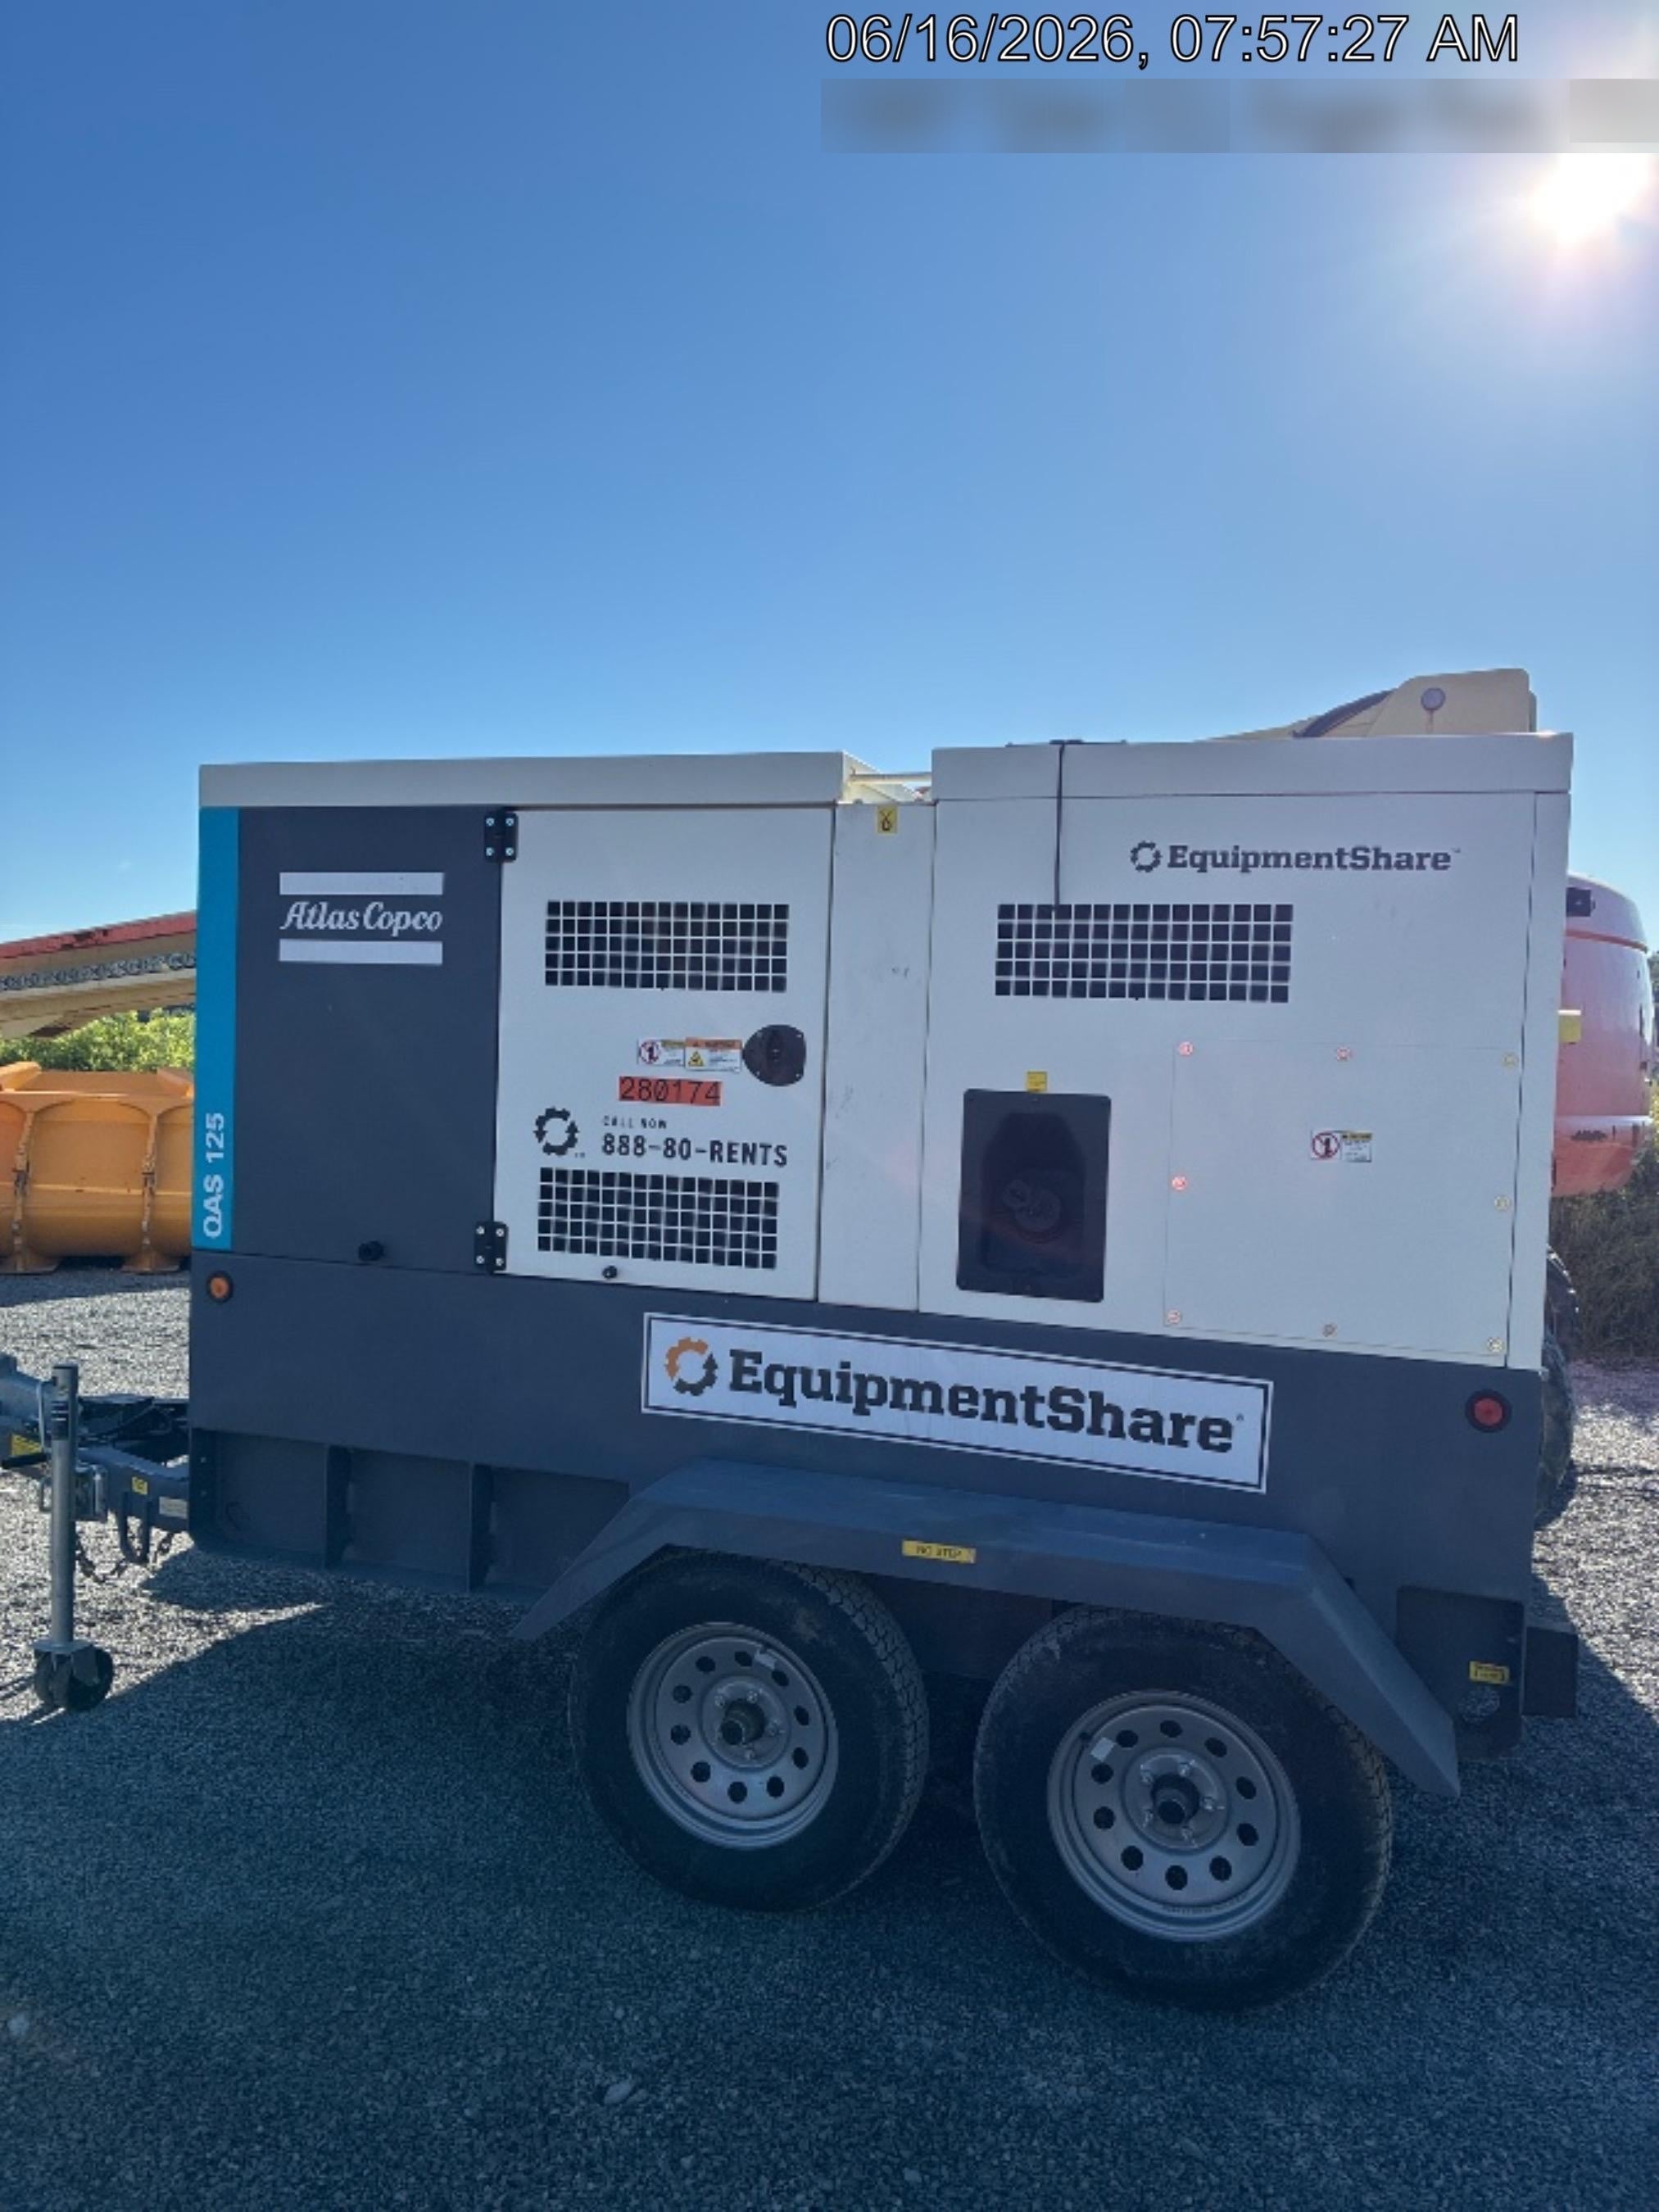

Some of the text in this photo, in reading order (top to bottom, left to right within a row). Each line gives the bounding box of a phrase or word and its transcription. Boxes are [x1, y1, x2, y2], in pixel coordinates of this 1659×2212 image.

[1167, 844, 1452, 873] EquipmentShare
[279, 901, 443, 937] Atlas Copco
[620, 1077, 720, 1105] 280174
[205, 1113, 224, 1163] 125
[602, 1133, 787, 1167] 888-80-RENTS
[728, 1349, 1234, 1454] EquipmentShare
